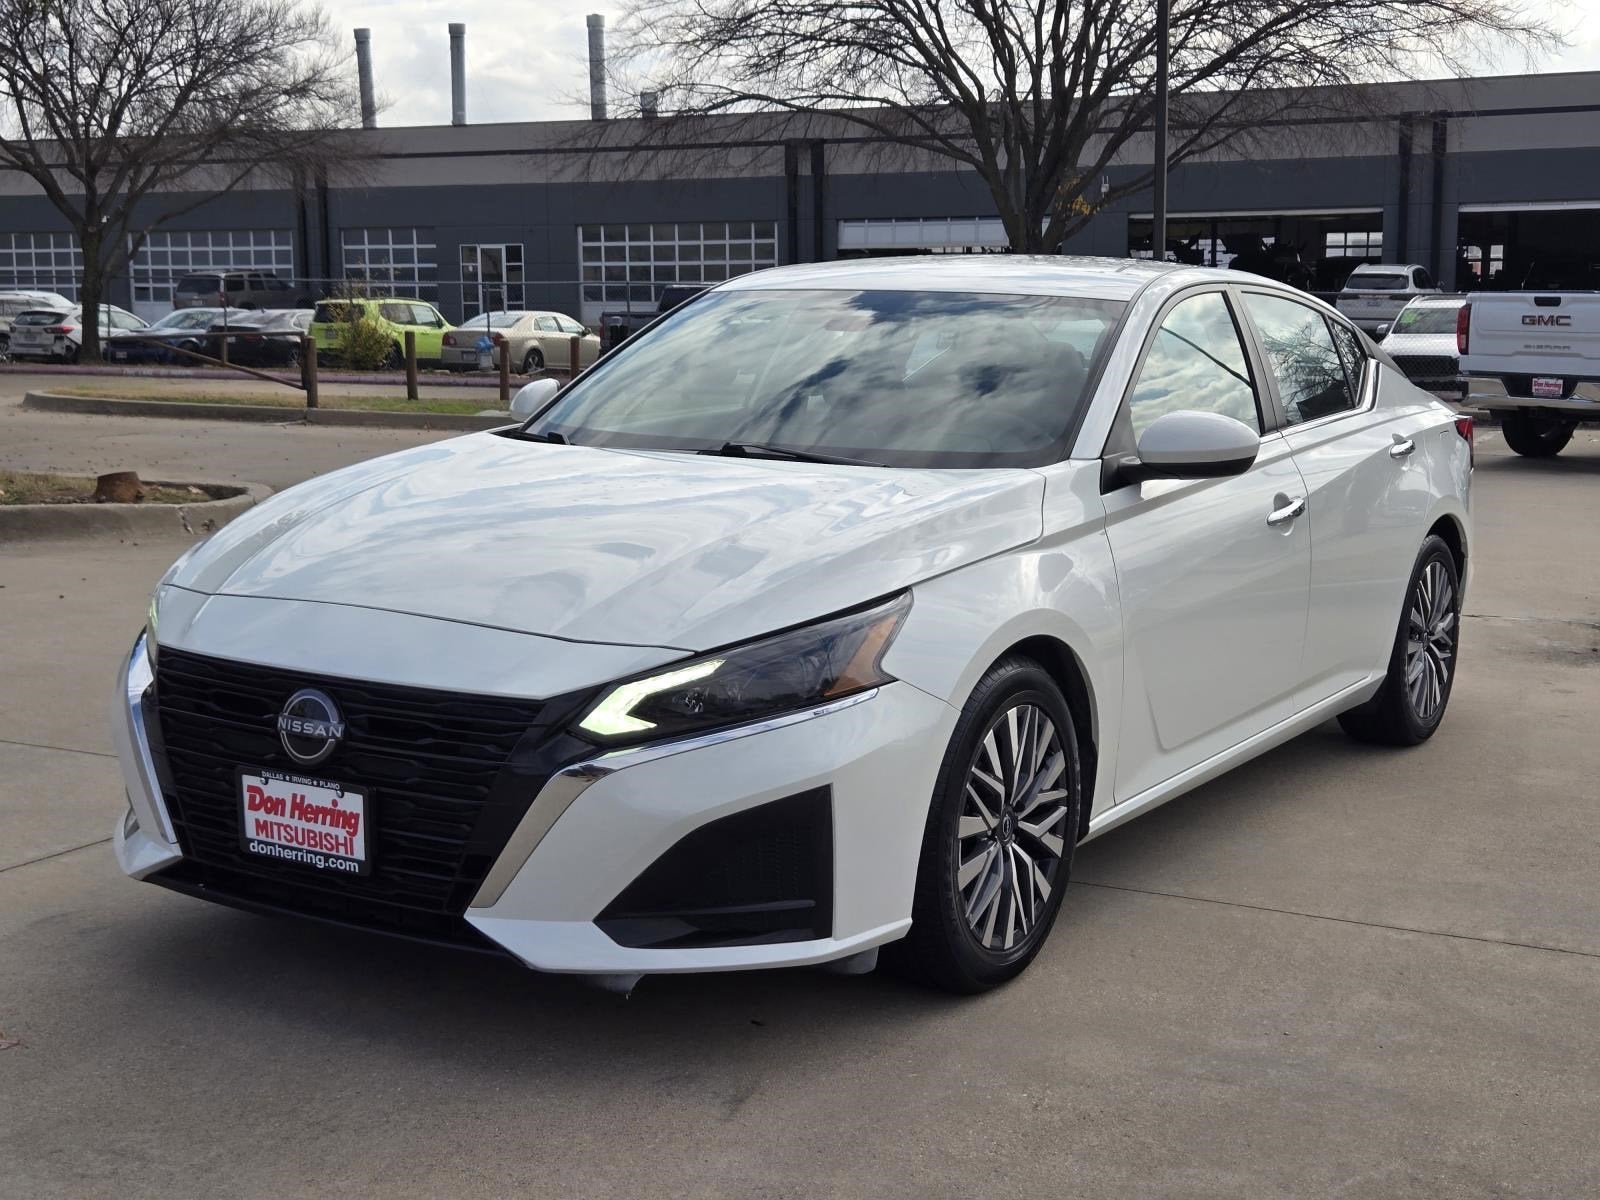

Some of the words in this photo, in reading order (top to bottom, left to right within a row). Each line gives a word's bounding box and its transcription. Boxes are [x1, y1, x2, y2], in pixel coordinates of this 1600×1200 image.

[1522, 315, 1571, 326] GMC
[278, 716, 342, 737] NISSAN
[261, 771, 284, 780] DALLAS
[291, 776, 312, 785] IRVING
[319, 780, 340, 789] PLANO
[247, 784, 287, 817] Don
[289, 793, 360, 837] Herring
[255, 818, 354, 856] MITSUBISHI
[249, 840, 359, 873] donherring.com
